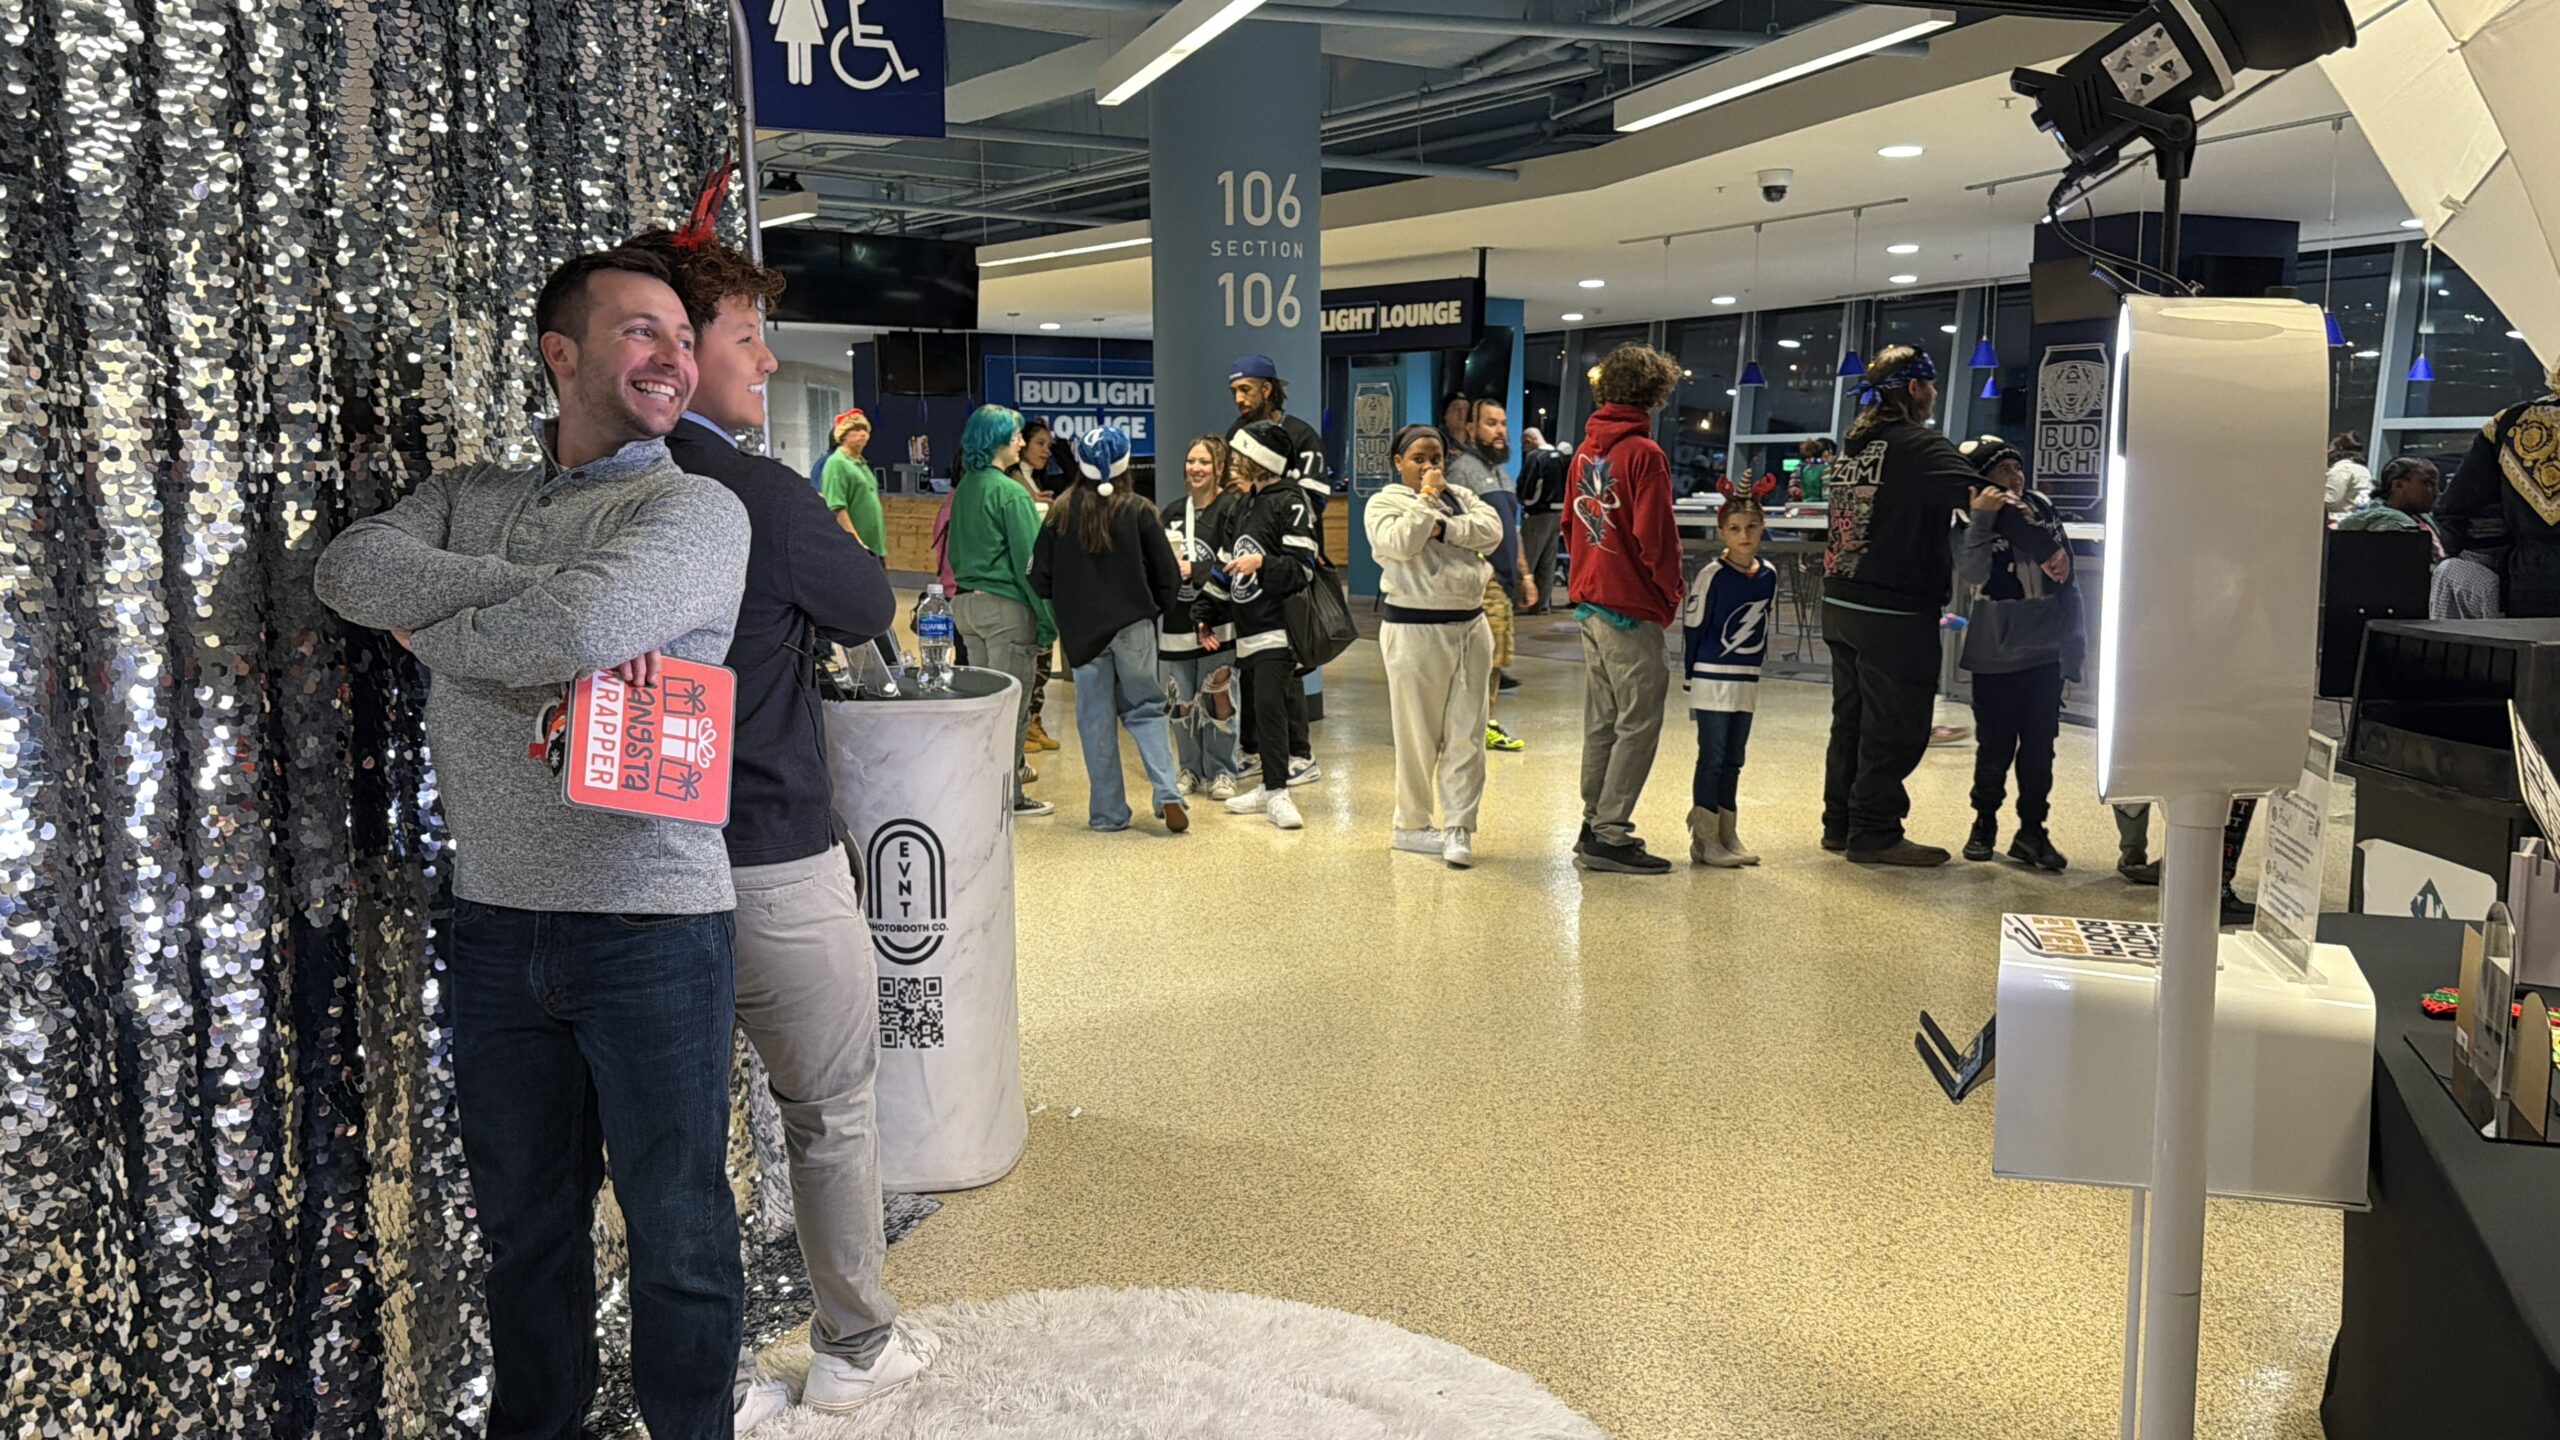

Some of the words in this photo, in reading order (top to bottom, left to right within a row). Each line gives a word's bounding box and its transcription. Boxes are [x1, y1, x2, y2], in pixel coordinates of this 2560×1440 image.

[1217, 170, 1301, 228] 106
[1210, 240, 1304, 259] SECTION
[1218, 272, 1301, 328] 106
[1321, 307, 1375, 332] LIGHT
[1380, 301, 1462, 328] LOUNGE
[1022, 380, 1081, 404] BUD
[1358, 439, 1387, 454] BUD
[2044, 426, 2097, 448] BUD
[1300, 451, 1324, 475] 77
[932, 922, 949, 932] CO.
[2032, 916, 2088, 954] EVER
[2076, 920, 2127, 958] BOOTH
